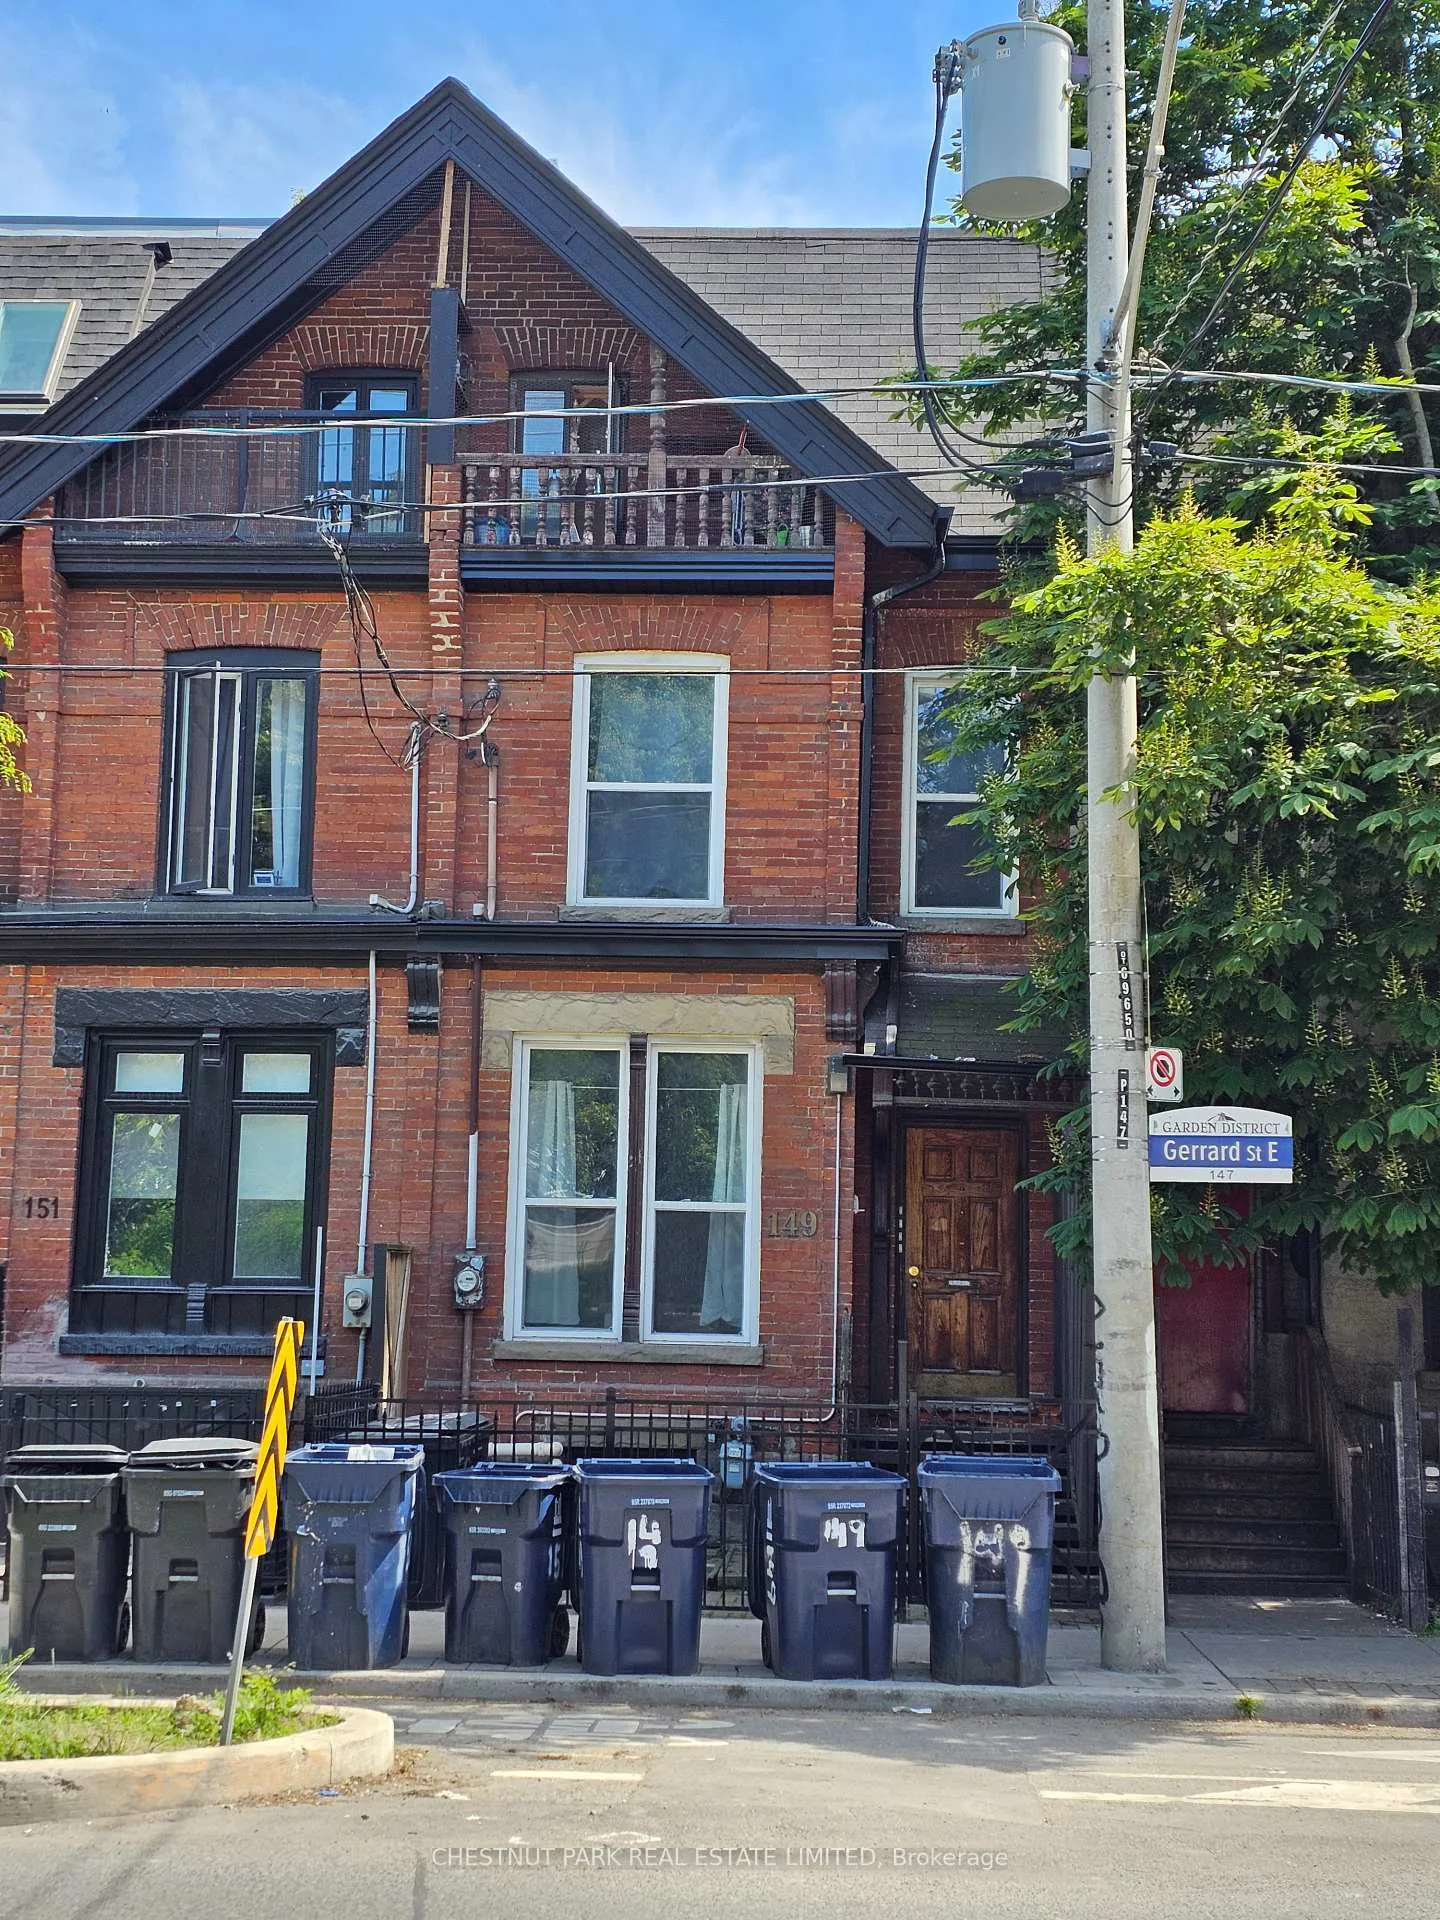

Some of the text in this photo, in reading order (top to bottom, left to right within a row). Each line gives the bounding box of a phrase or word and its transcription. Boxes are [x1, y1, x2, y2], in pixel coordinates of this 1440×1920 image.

[1119, 1078, 1129, 1138] P147
[1162, 1121, 1280, 1135] GARDEN DISTRICT
[1163, 1139, 1279, 1162] Gerrard St E
[1210, 1169, 1234, 1181] 147
[25, 1196, 59, 1219] 151
[767, 1210, 818, 1237] 149
[824, 1517, 866, 1548] 149
[957, 1520, 1032, 1614] 149
